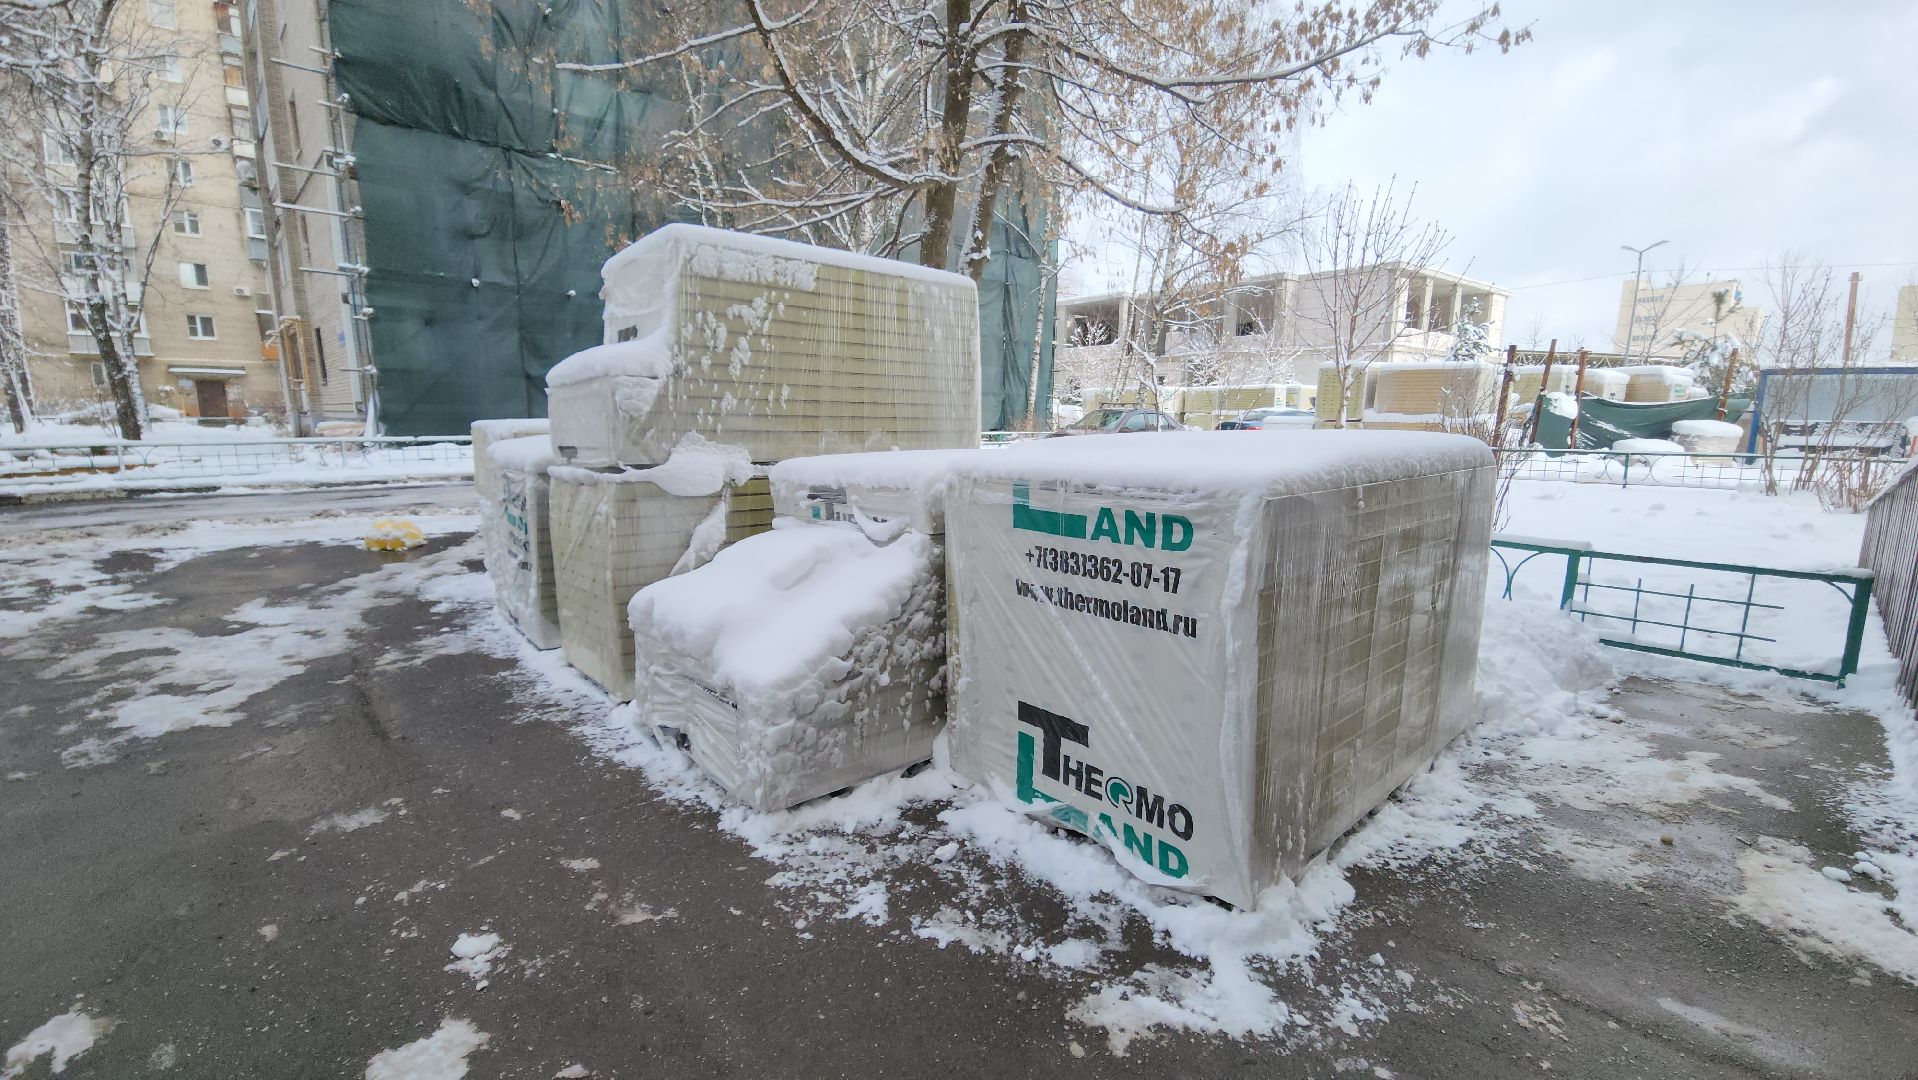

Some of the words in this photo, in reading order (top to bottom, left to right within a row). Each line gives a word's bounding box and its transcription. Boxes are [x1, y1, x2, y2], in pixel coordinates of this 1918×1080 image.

[1012, 480, 1195, 552] LAND
[1025, 545, 1181, 595] +7(383)362-07-17
[1015, 578, 1198, 639] www.thermoland.ru
